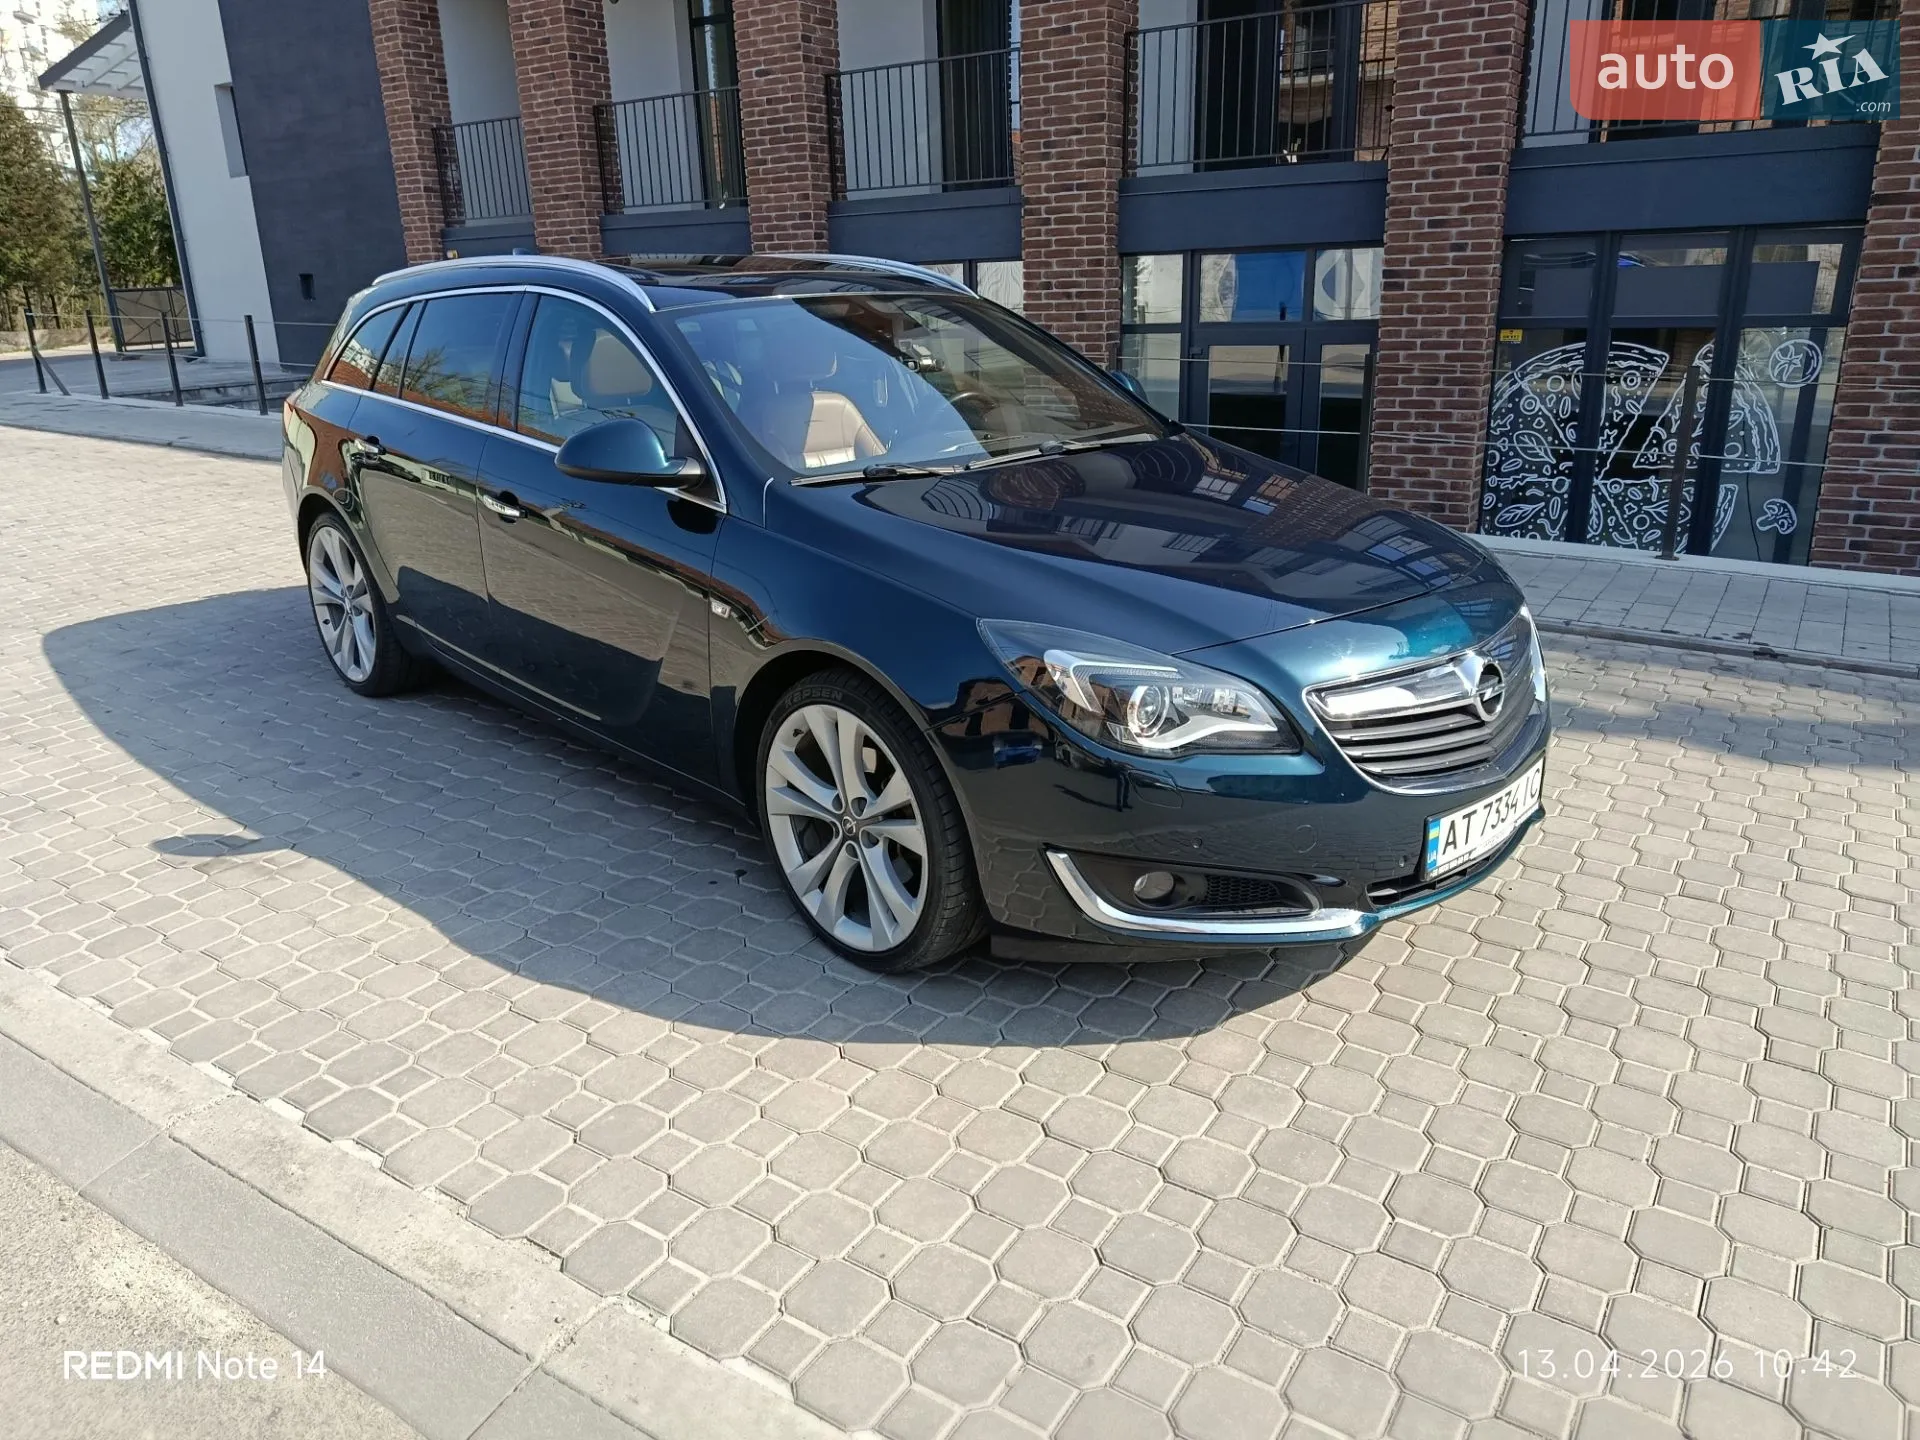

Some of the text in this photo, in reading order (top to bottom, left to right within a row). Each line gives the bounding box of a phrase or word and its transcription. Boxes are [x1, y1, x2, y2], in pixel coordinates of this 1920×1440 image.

[1442, 809, 1477, 856] AT
[1480, 784, 1521, 837] 7334
[1523, 767, 1540, 807] IC
